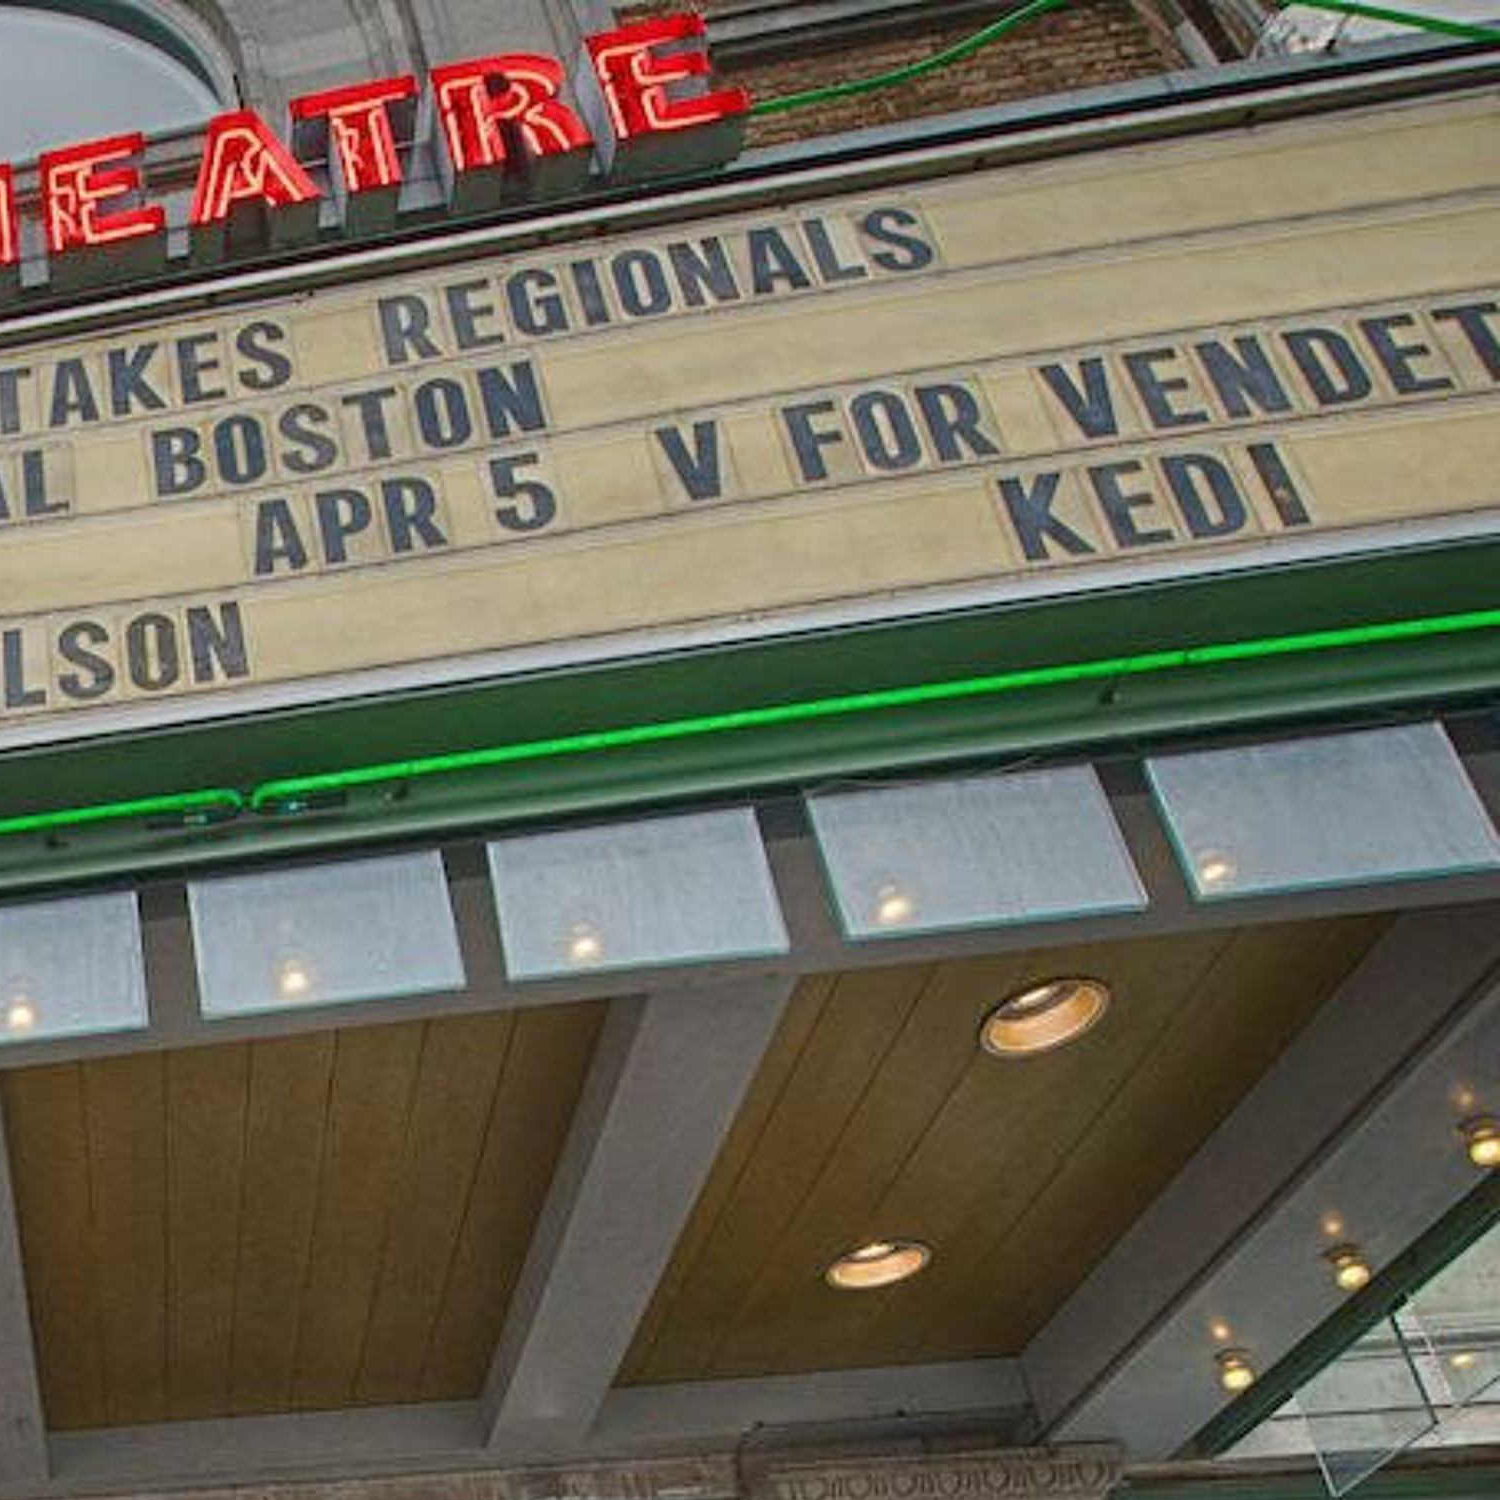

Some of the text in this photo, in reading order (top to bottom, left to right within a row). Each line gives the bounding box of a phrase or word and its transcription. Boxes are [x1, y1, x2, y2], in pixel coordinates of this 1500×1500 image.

[377, 207, 934, 365] REGIONALS
[151, 359, 547, 495] BOSTON
[253, 475, 449, 576] APR
[490, 452, 558, 532] 5
[655, 420, 723, 502] V
[781, 382, 1000, 484] FOR
[997, 442, 1311, 561] KEDI
